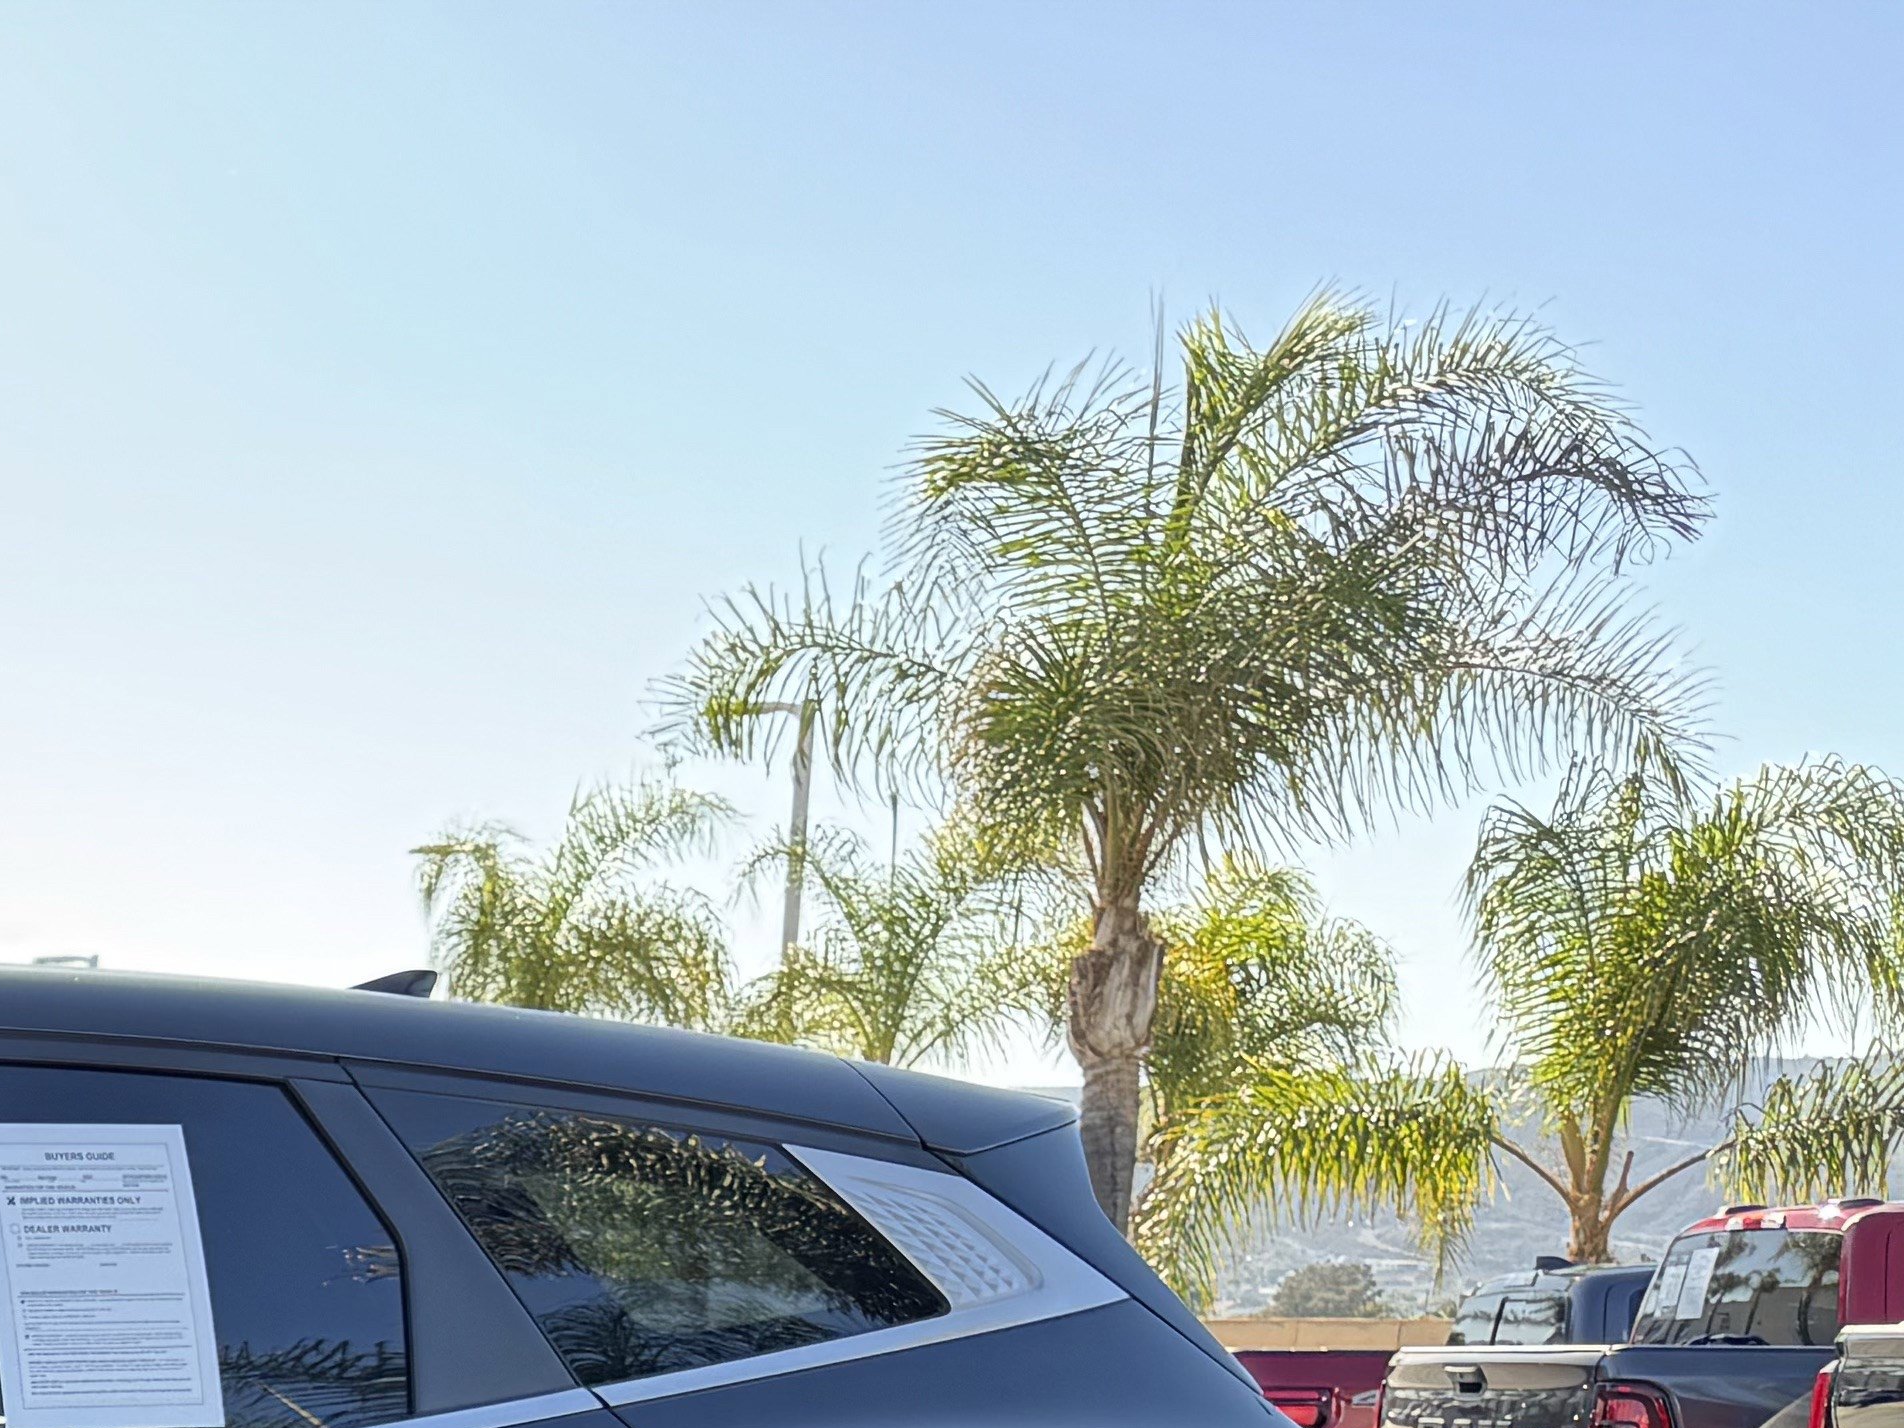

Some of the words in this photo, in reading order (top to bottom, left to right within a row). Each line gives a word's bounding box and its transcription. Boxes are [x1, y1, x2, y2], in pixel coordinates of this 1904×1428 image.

[44, 1152, 84, 1161] BUYERS
[86, 1152, 116, 1161] GUIDE
[20, 1196, 55, 1205] IMPLIED
[57, 1196, 116, 1205] WARRANTIES
[118, 1196, 141, 1205] ONLY
[24, 1225, 60, 1234] DEALER
[62, 1225, 112, 1234] WARRANTY
